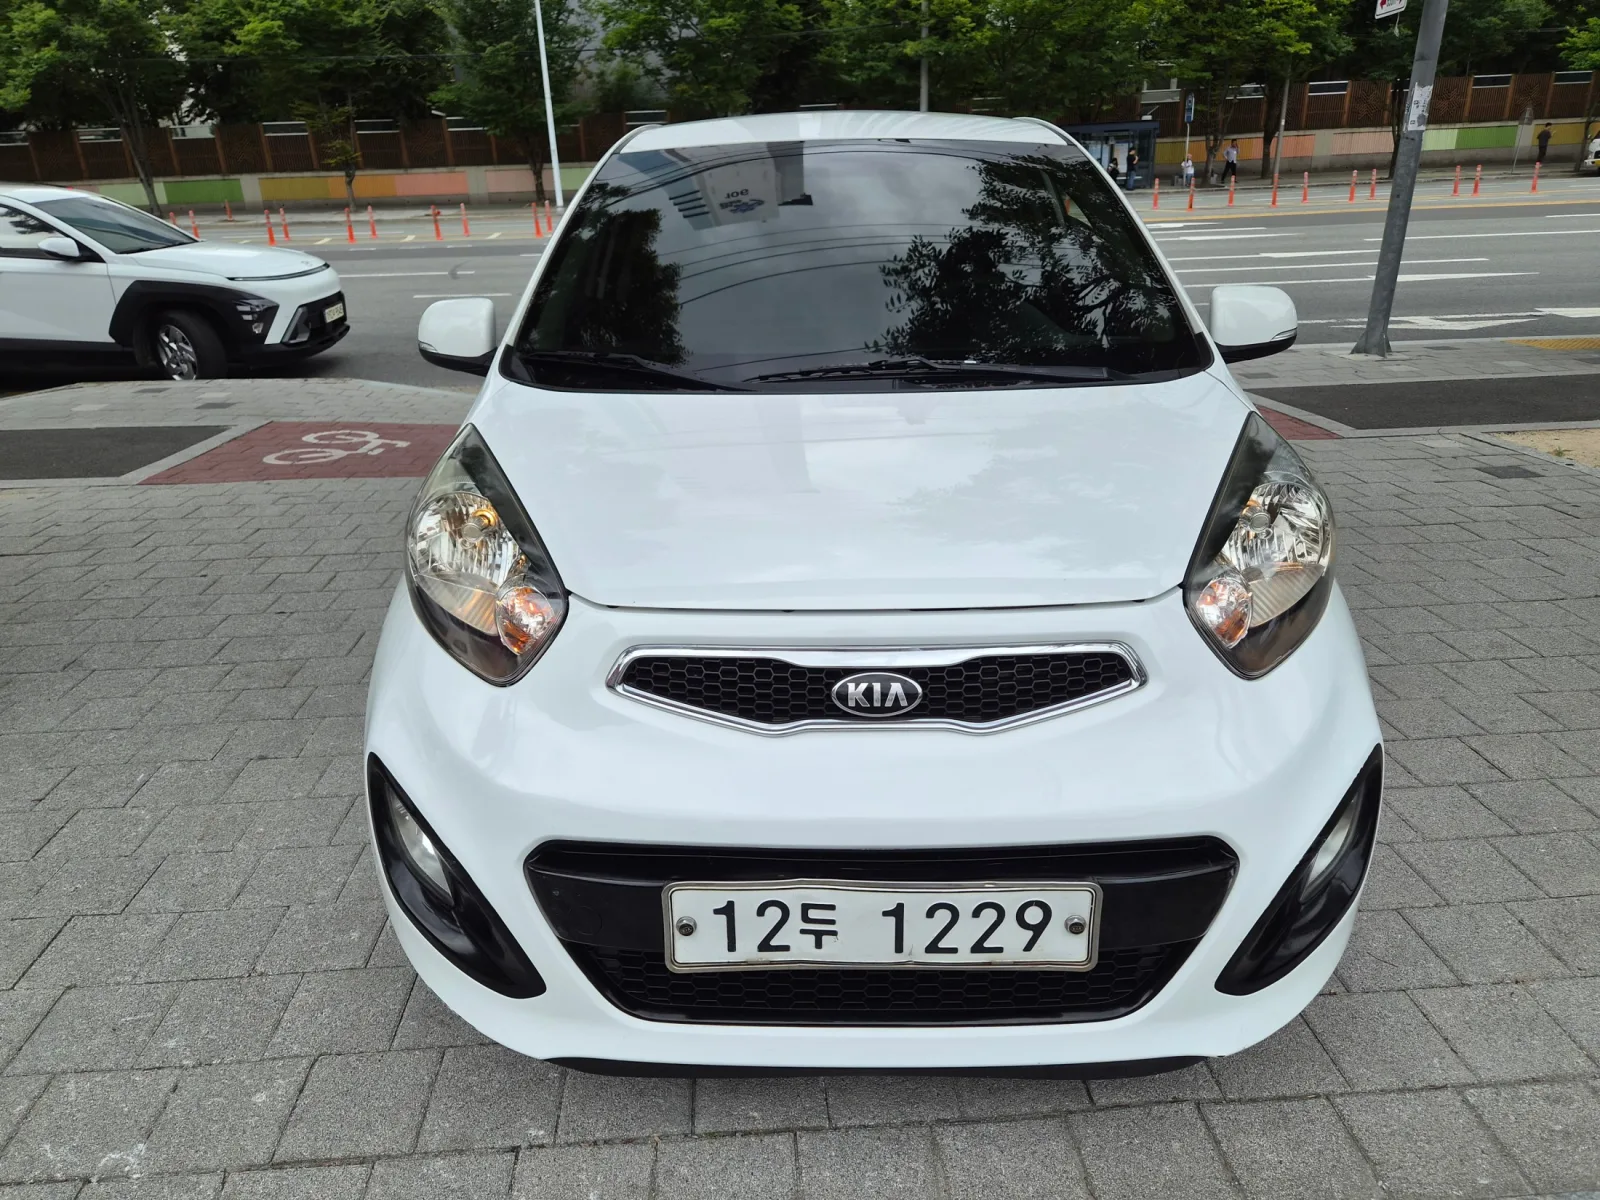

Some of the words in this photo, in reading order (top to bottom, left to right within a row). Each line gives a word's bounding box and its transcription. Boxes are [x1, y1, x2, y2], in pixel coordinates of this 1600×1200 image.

[846, 682, 909, 707] KIA
[712, 899, 839, 953] 12두
[881, 899, 1053, 955] 1229
